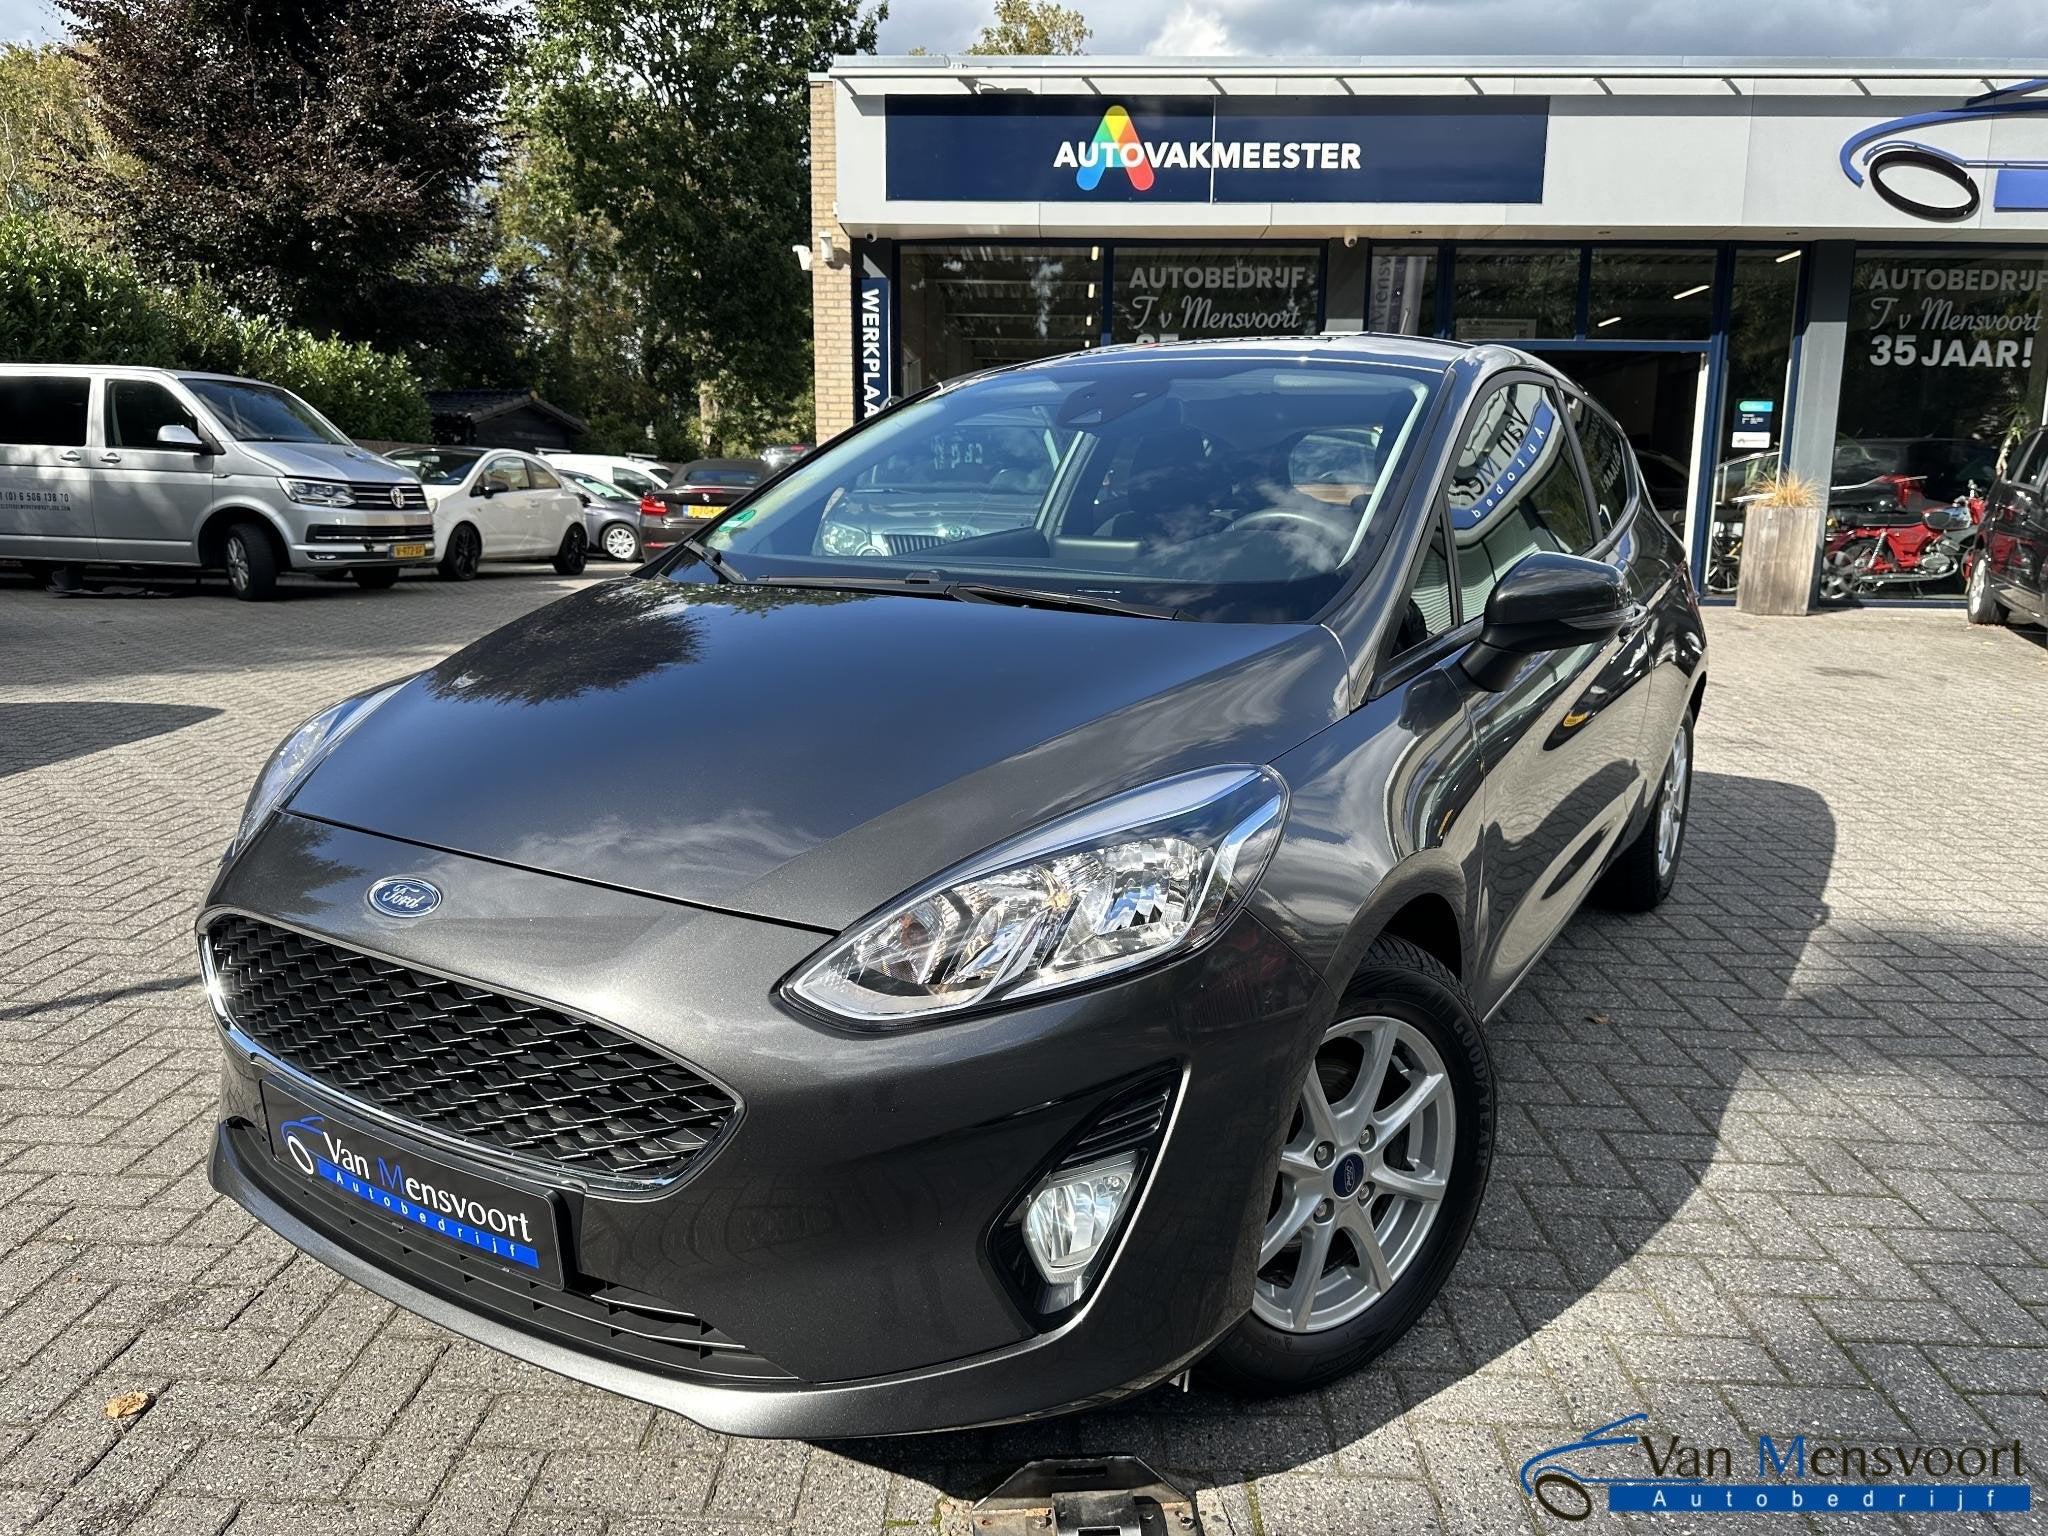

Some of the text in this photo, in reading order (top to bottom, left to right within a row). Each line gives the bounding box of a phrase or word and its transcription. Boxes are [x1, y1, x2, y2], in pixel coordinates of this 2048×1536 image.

[1053, 141, 1362, 169] AUTOVAKMEESTER
[1129, 267, 1306, 289] AUTOBEDRIJF
[1132, 295, 1159, 330] T
[1181, 294, 1301, 330] Mensvoort
[1870, 296, 1899, 331] T
[1920, 296, 2043, 332] Mensvoort
[1869, 334, 2034, 368] 35 JAAR!
[382, 884, 426, 909] Ford
[322, 1131, 533, 1243] Van Mensvoort
[336, 1170, 518, 1258] Autobedrijf
